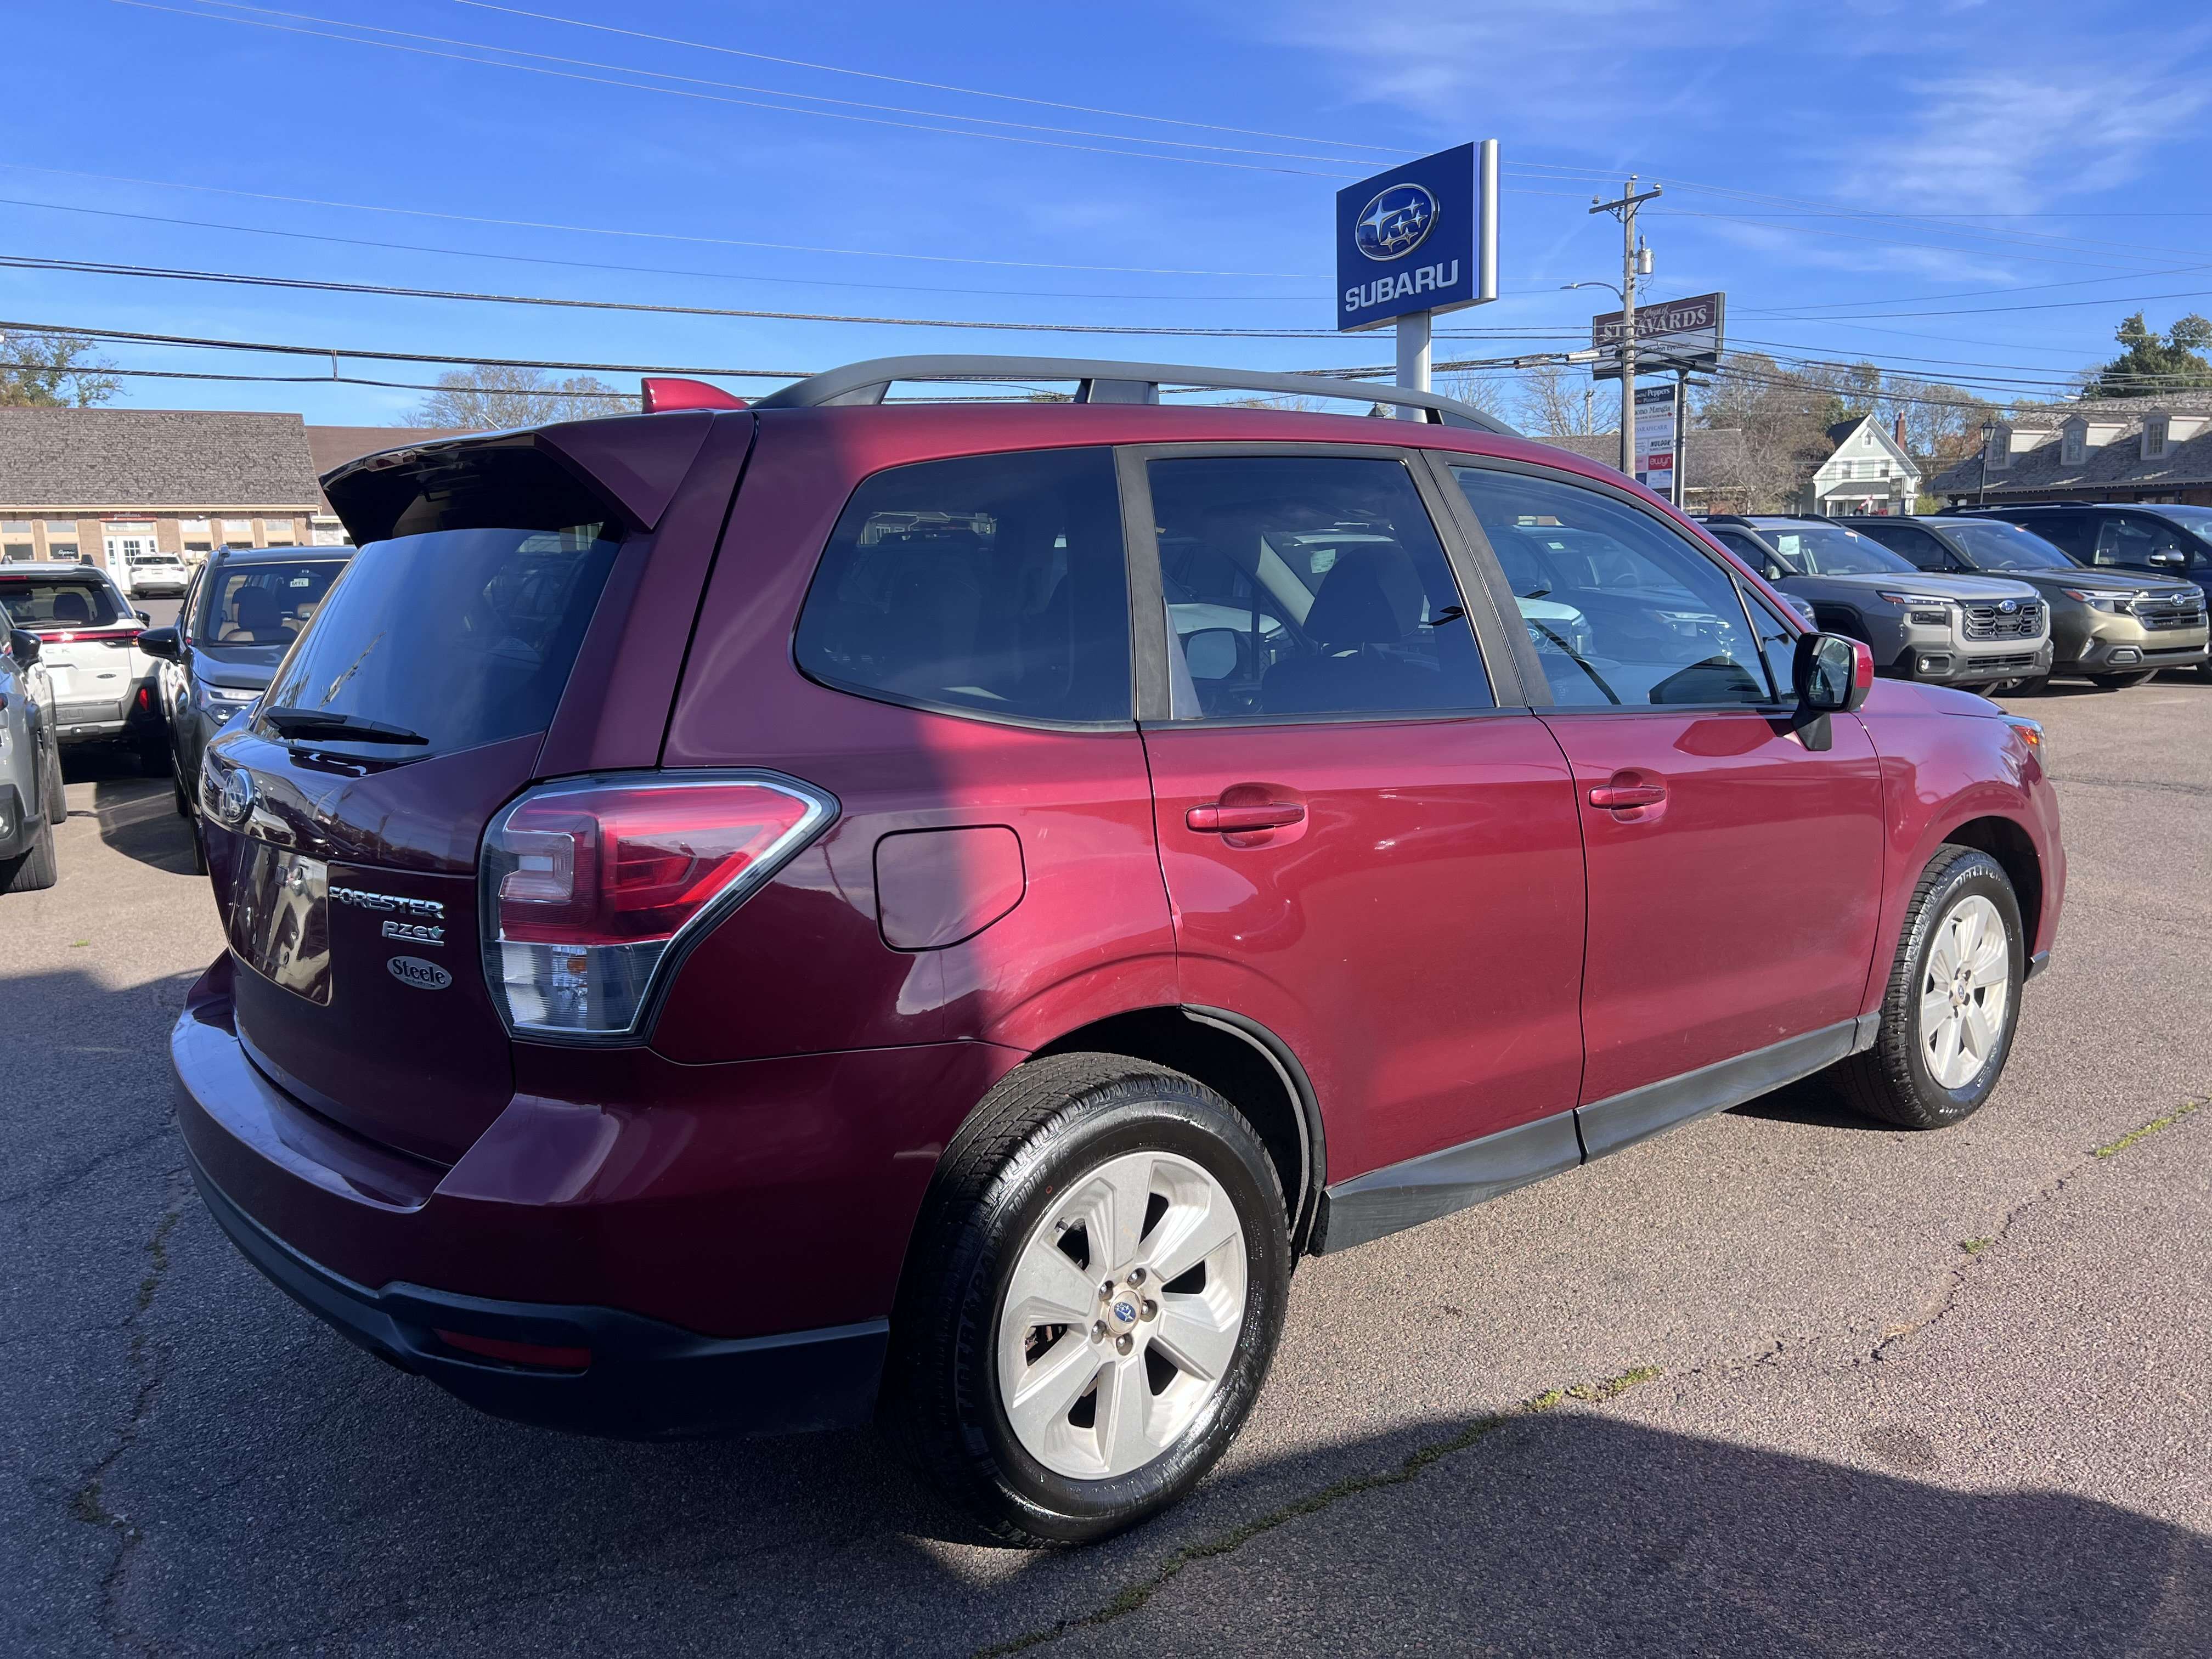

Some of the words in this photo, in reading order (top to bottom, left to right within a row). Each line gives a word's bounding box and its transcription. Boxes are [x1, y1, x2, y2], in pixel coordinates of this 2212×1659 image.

[1345, 259, 1459, 312] SUBARU
[329, 886, 445, 919] FORESTER
[392, 958, 446, 985] Steele
